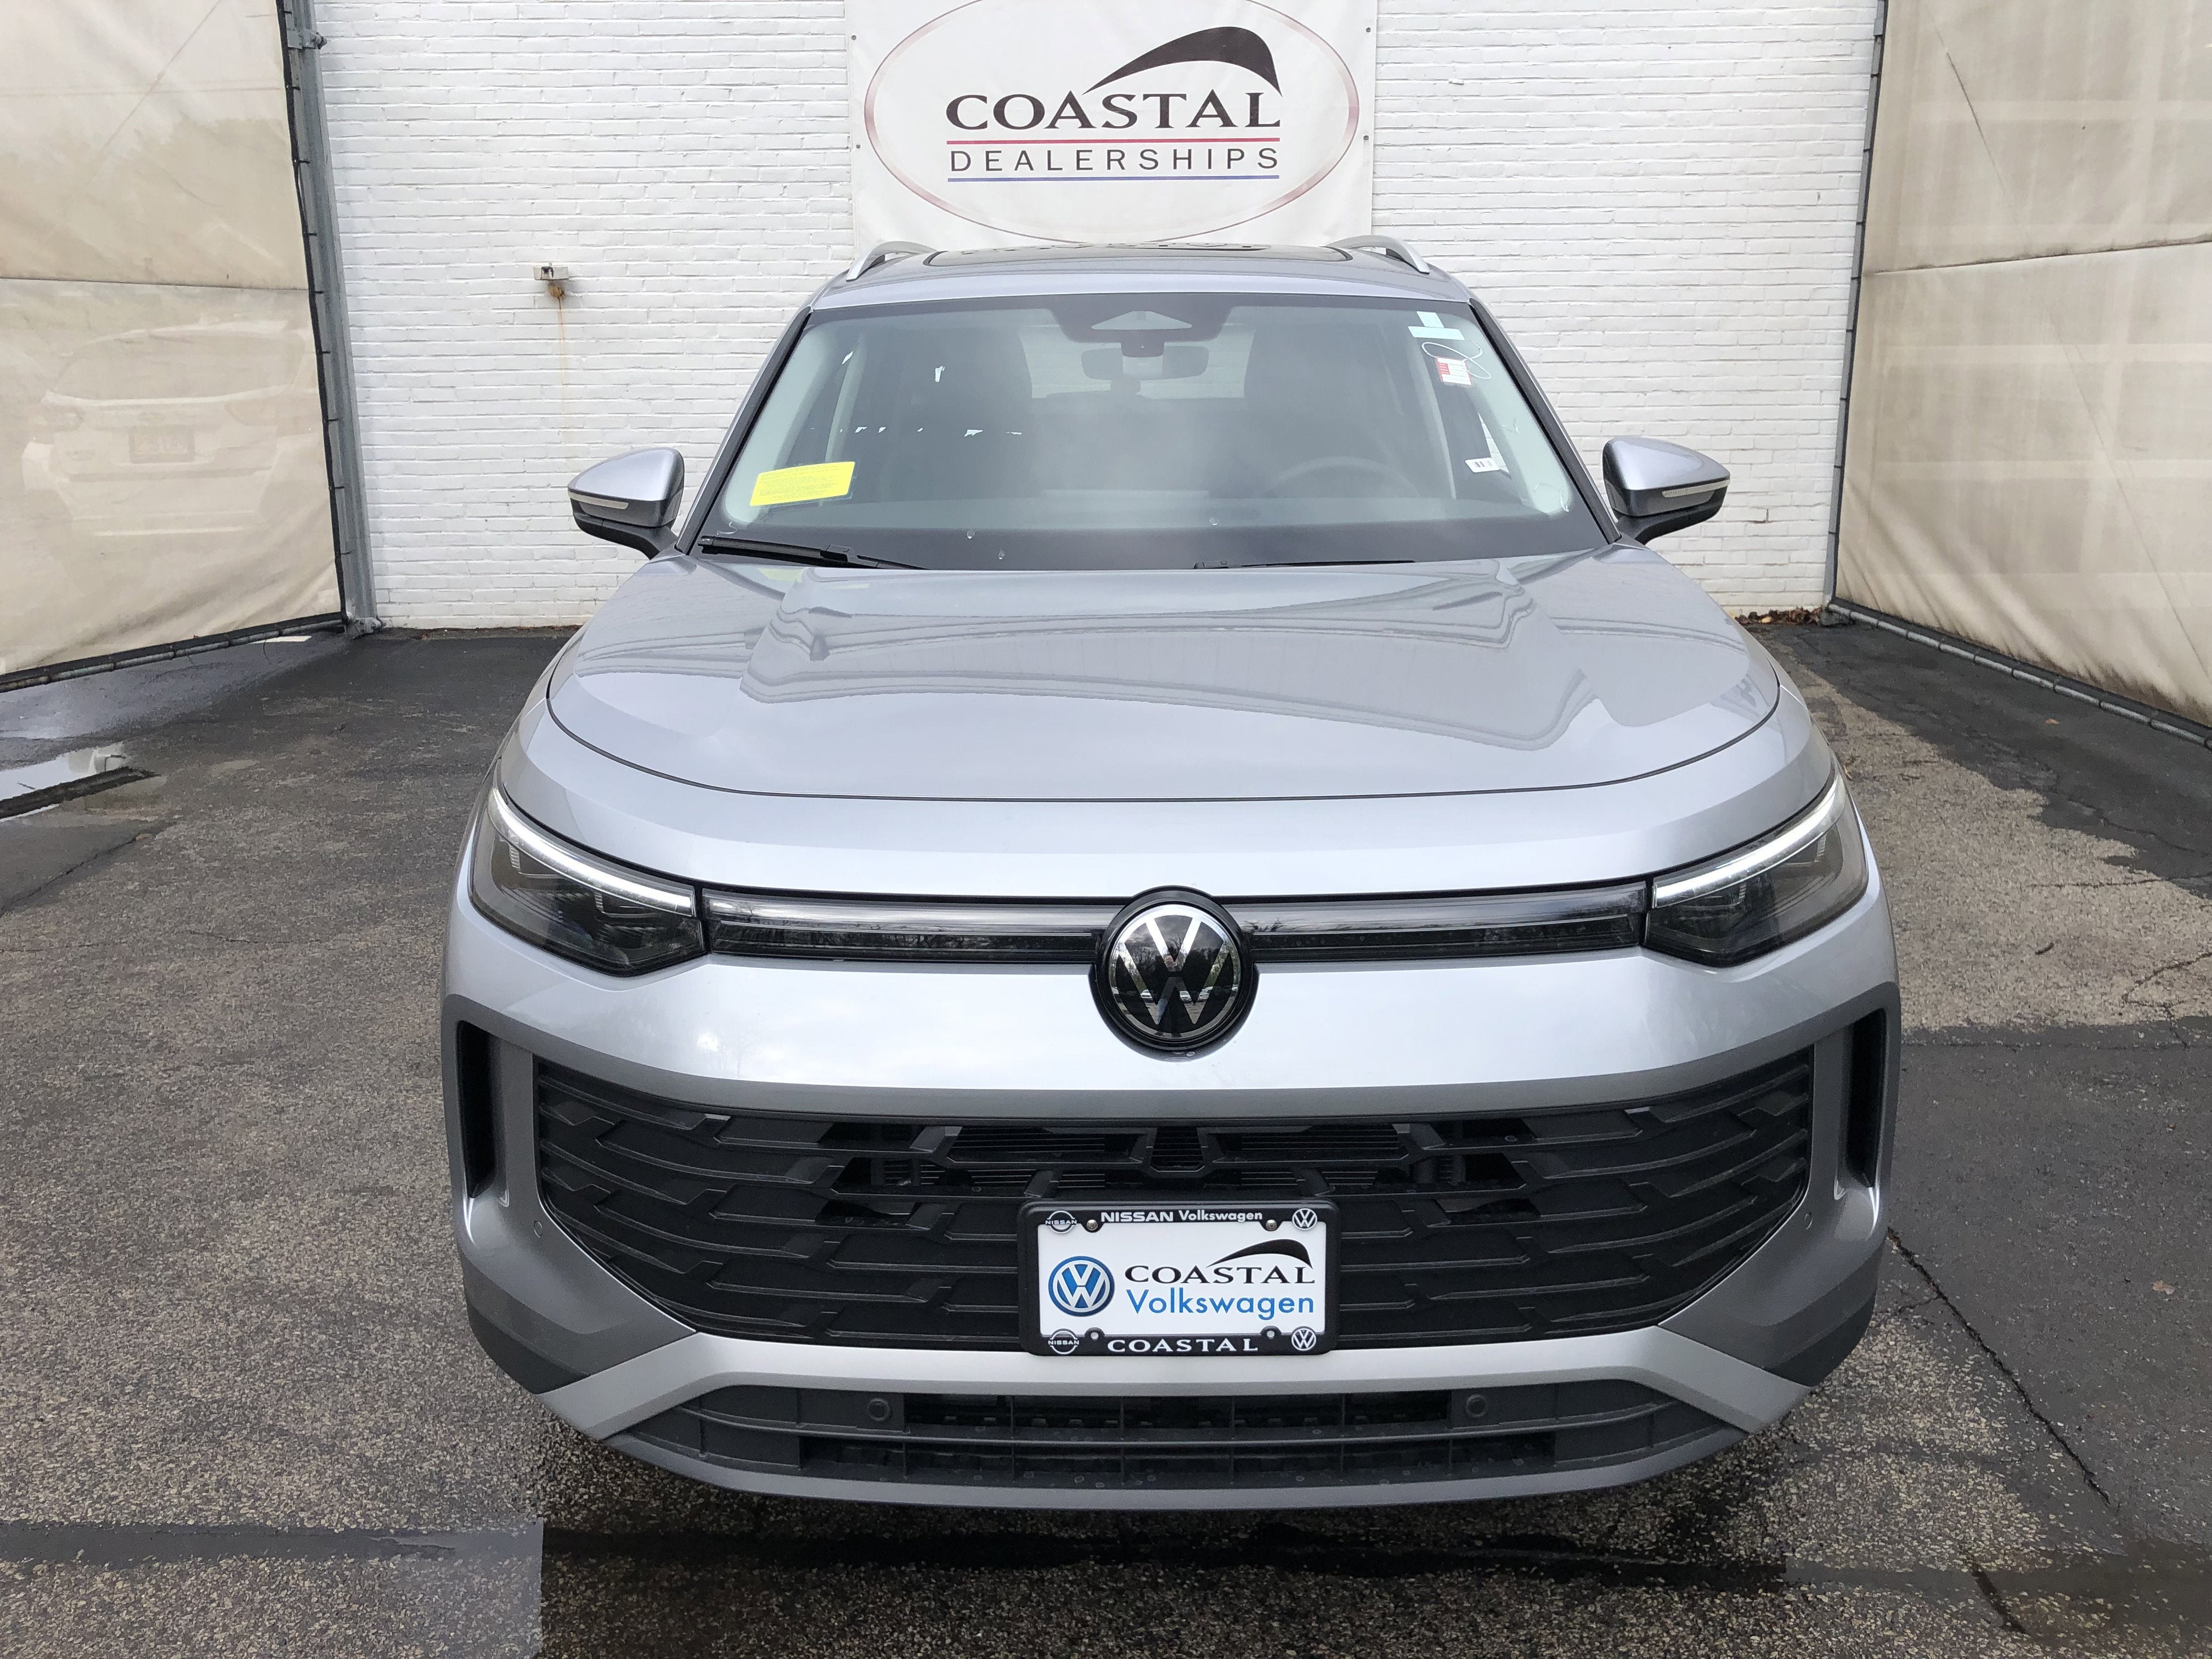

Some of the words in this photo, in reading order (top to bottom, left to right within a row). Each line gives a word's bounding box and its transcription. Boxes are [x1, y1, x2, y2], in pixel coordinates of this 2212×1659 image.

[946, 89, 1280, 130] COASTAL
[950, 148, 1278, 172] DEALERSHIPS
[1101, 1212, 1173, 1222] NISSAN
[1178, 1210, 1262, 1222] Volkswagen
[1125, 1265, 1316, 1284] COASTAL
[1126, 1287, 1314, 1320] Volkswagen
[1107, 1339, 1259, 1352] COASTAL
